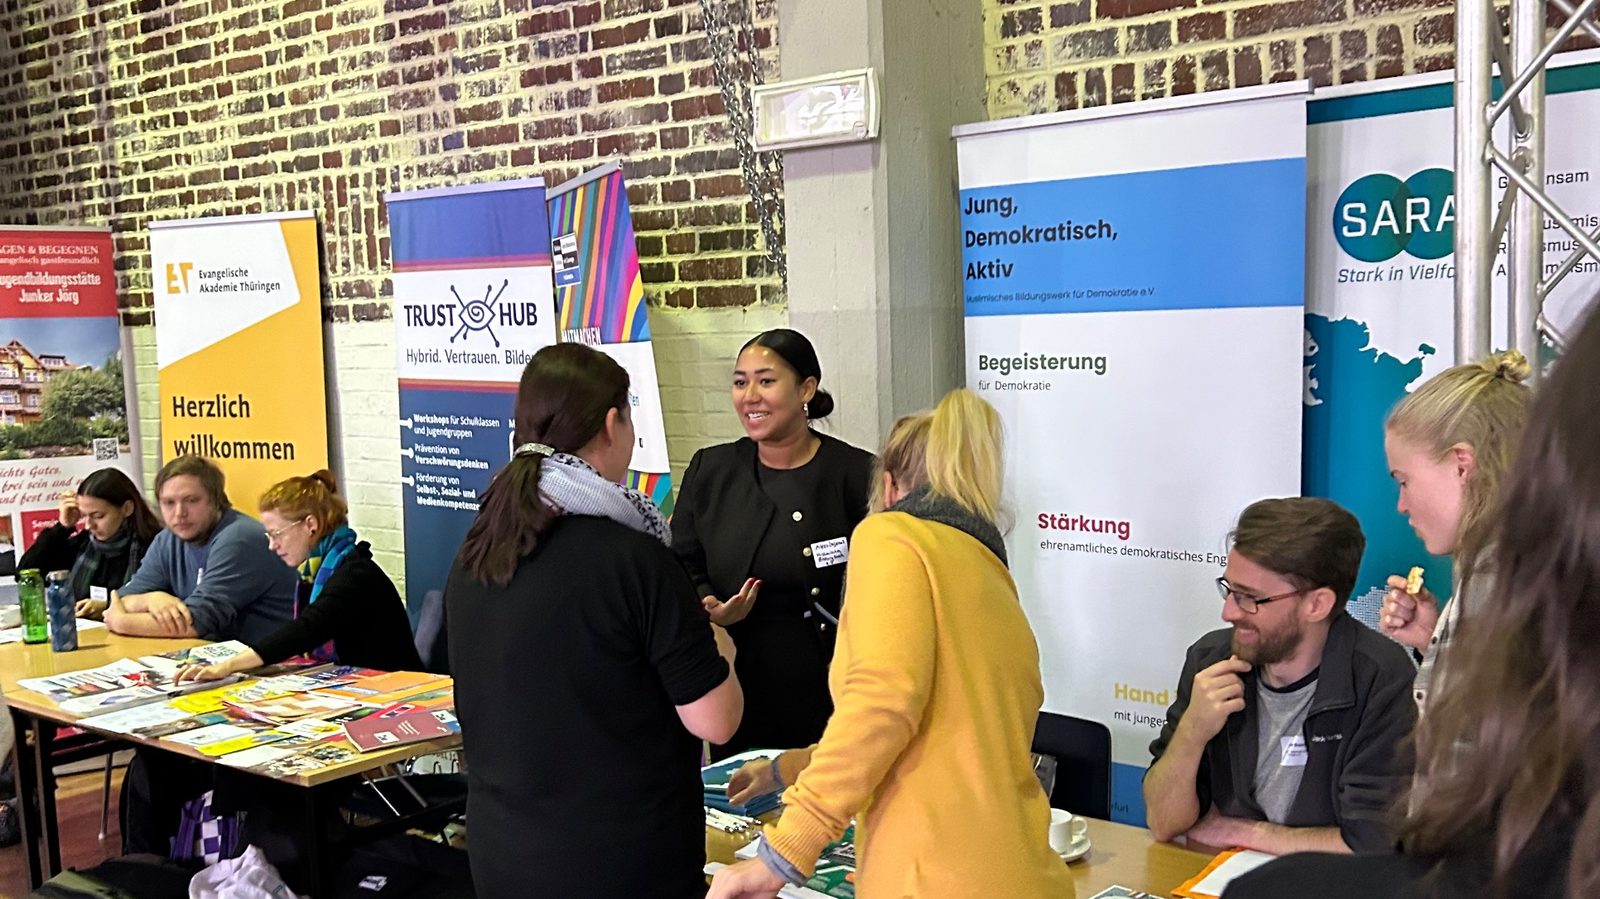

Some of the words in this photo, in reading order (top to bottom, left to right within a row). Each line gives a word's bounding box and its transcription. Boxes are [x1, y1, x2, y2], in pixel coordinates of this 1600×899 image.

[964, 196, 1018, 218] Jung,
[1342, 194, 1455, 238] SARA
[965, 219, 1118, 248] Demokratisch,
[0, 245, 25, 254] GEN
[38, 245, 99, 254] BEGEGNEN
[199, 267, 249, 280] Evangelische
[965, 259, 1014, 280] Aktiv
[1338, 266, 1384, 283] Stark
[1388, 265, 1404, 281] in
[199, 282, 238, 293] Akademie
[239, 281, 281, 294] Thüringen
[1015, 291, 1071, 303] Bildungswerk
[1072, 289, 1085, 299] für
[1086, 287, 1139, 298] Demokratie
[19, 288, 54, 302] Junker
[56, 288, 79, 305] Jörg
[404, 303, 456, 327] TRUST
[499, 302, 538, 326] HUB
[406, 348, 442, 365] Hybrid.
[444, 348, 500, 364] Vertrauen.
[505, 349, 533, 365] Bilde
[978, 352, 1107, 376] Begeisterung
[978, 380, 990, 391] für
[994, 380, 1051, 391] Demokratie
[172, 393, 250, 418] Herzlich
[413, 414, 449, 426] Workshops
[450, 415, 460, 425] für
[460, 416, 500, 428] Schulklassen
[414, 426, 426, 435] und
[426, 428, 473, 439] Jugendgruppen
[173, 433, 295, 460] willkommen
[414, 443, 448, 454] Prävention
[448, 447, 460, 455] von
[415, 456, 489, 470] Verschwörungsdenken
[415, 472, 448, 486] Förderung
[463, 489, 476, 498] und
[1037, 512, 1131, 541] Stärkung
[1040, 539, 1118, 555] ehrenamtliches
[1120, 545, 1203, 562] demokratisches
[1206, 552, 1227, 567] Eng
[1114, 683, 1170, 706] Hand
[1114, 710, 1131, 722] mit
